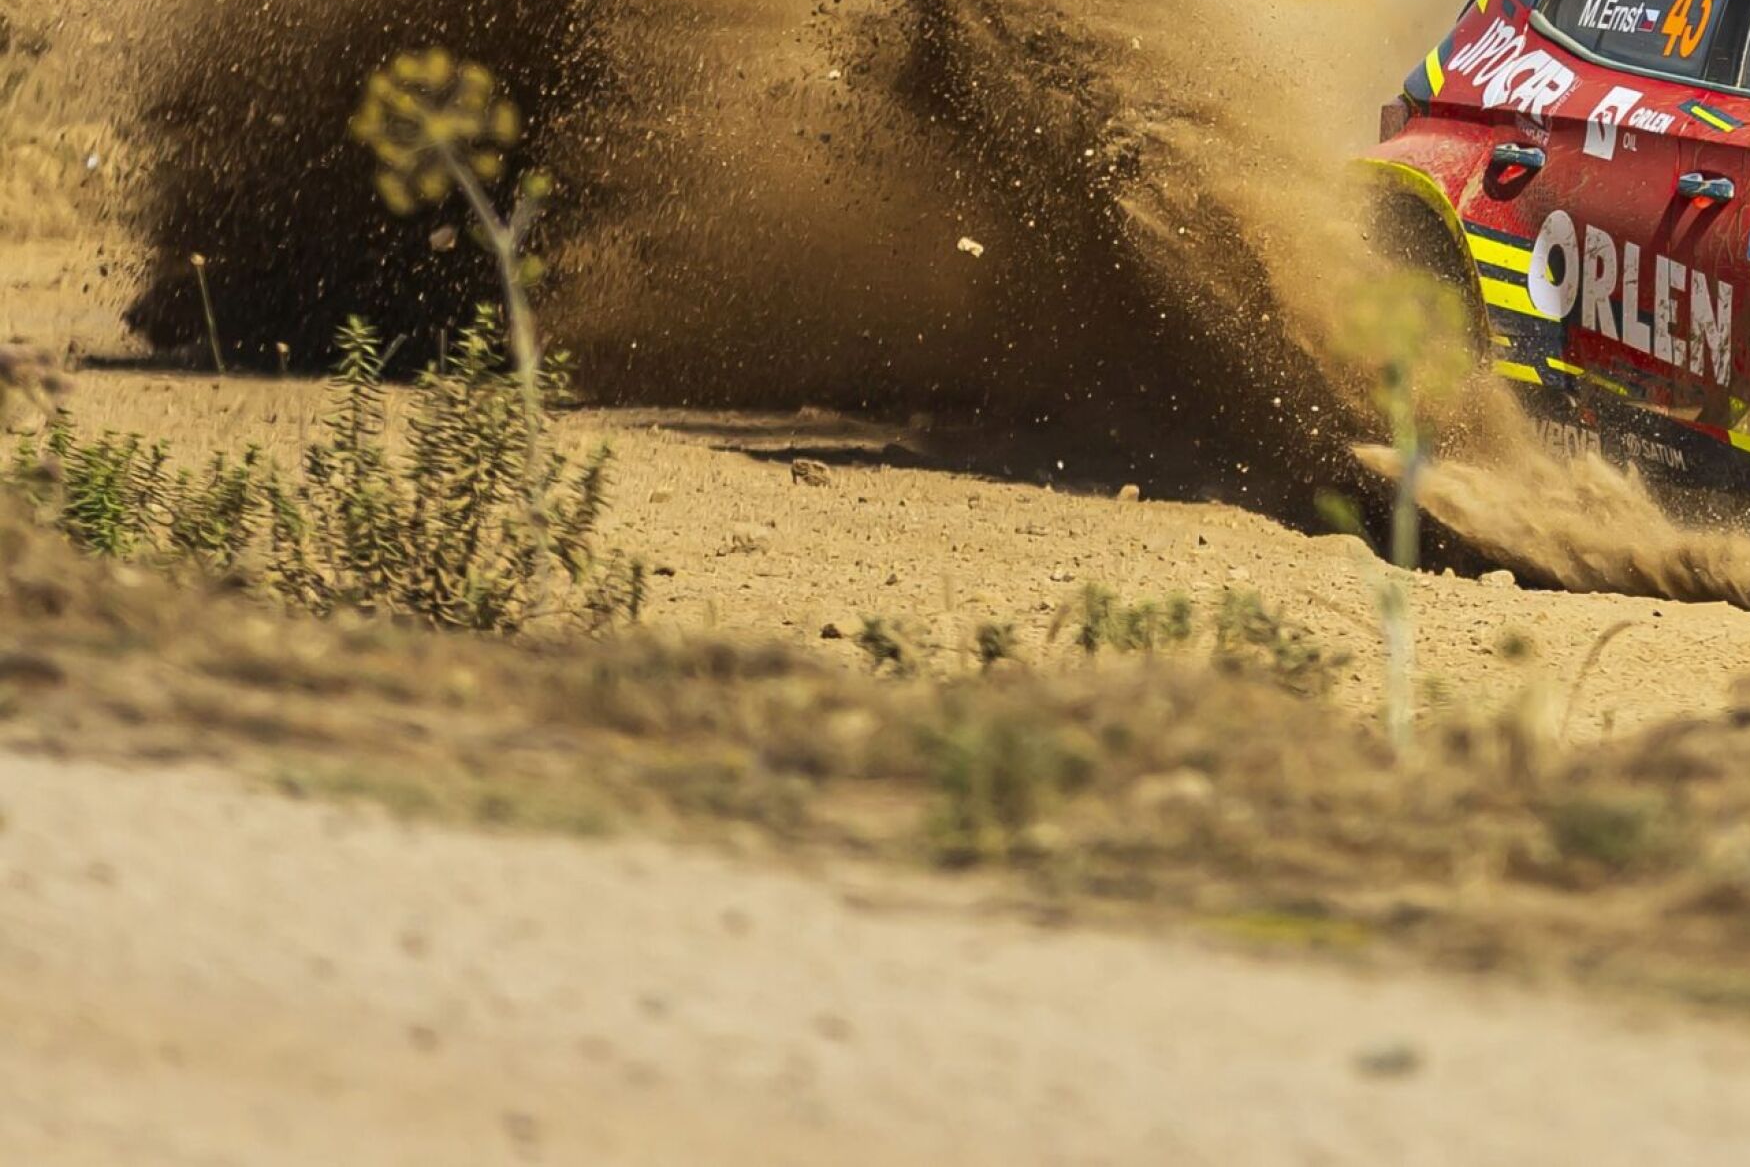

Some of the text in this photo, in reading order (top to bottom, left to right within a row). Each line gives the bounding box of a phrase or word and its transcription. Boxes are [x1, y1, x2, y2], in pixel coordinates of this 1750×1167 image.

[1447, 16, 1575, 129] JIPOCAR
[1628, 107, 1675, 134] ORLEN
[1622, 132, 1638, 152] OIL
[1527, 209, 1733, 388] ORLEN
[1641, 438, 1688, 472] SATUM
